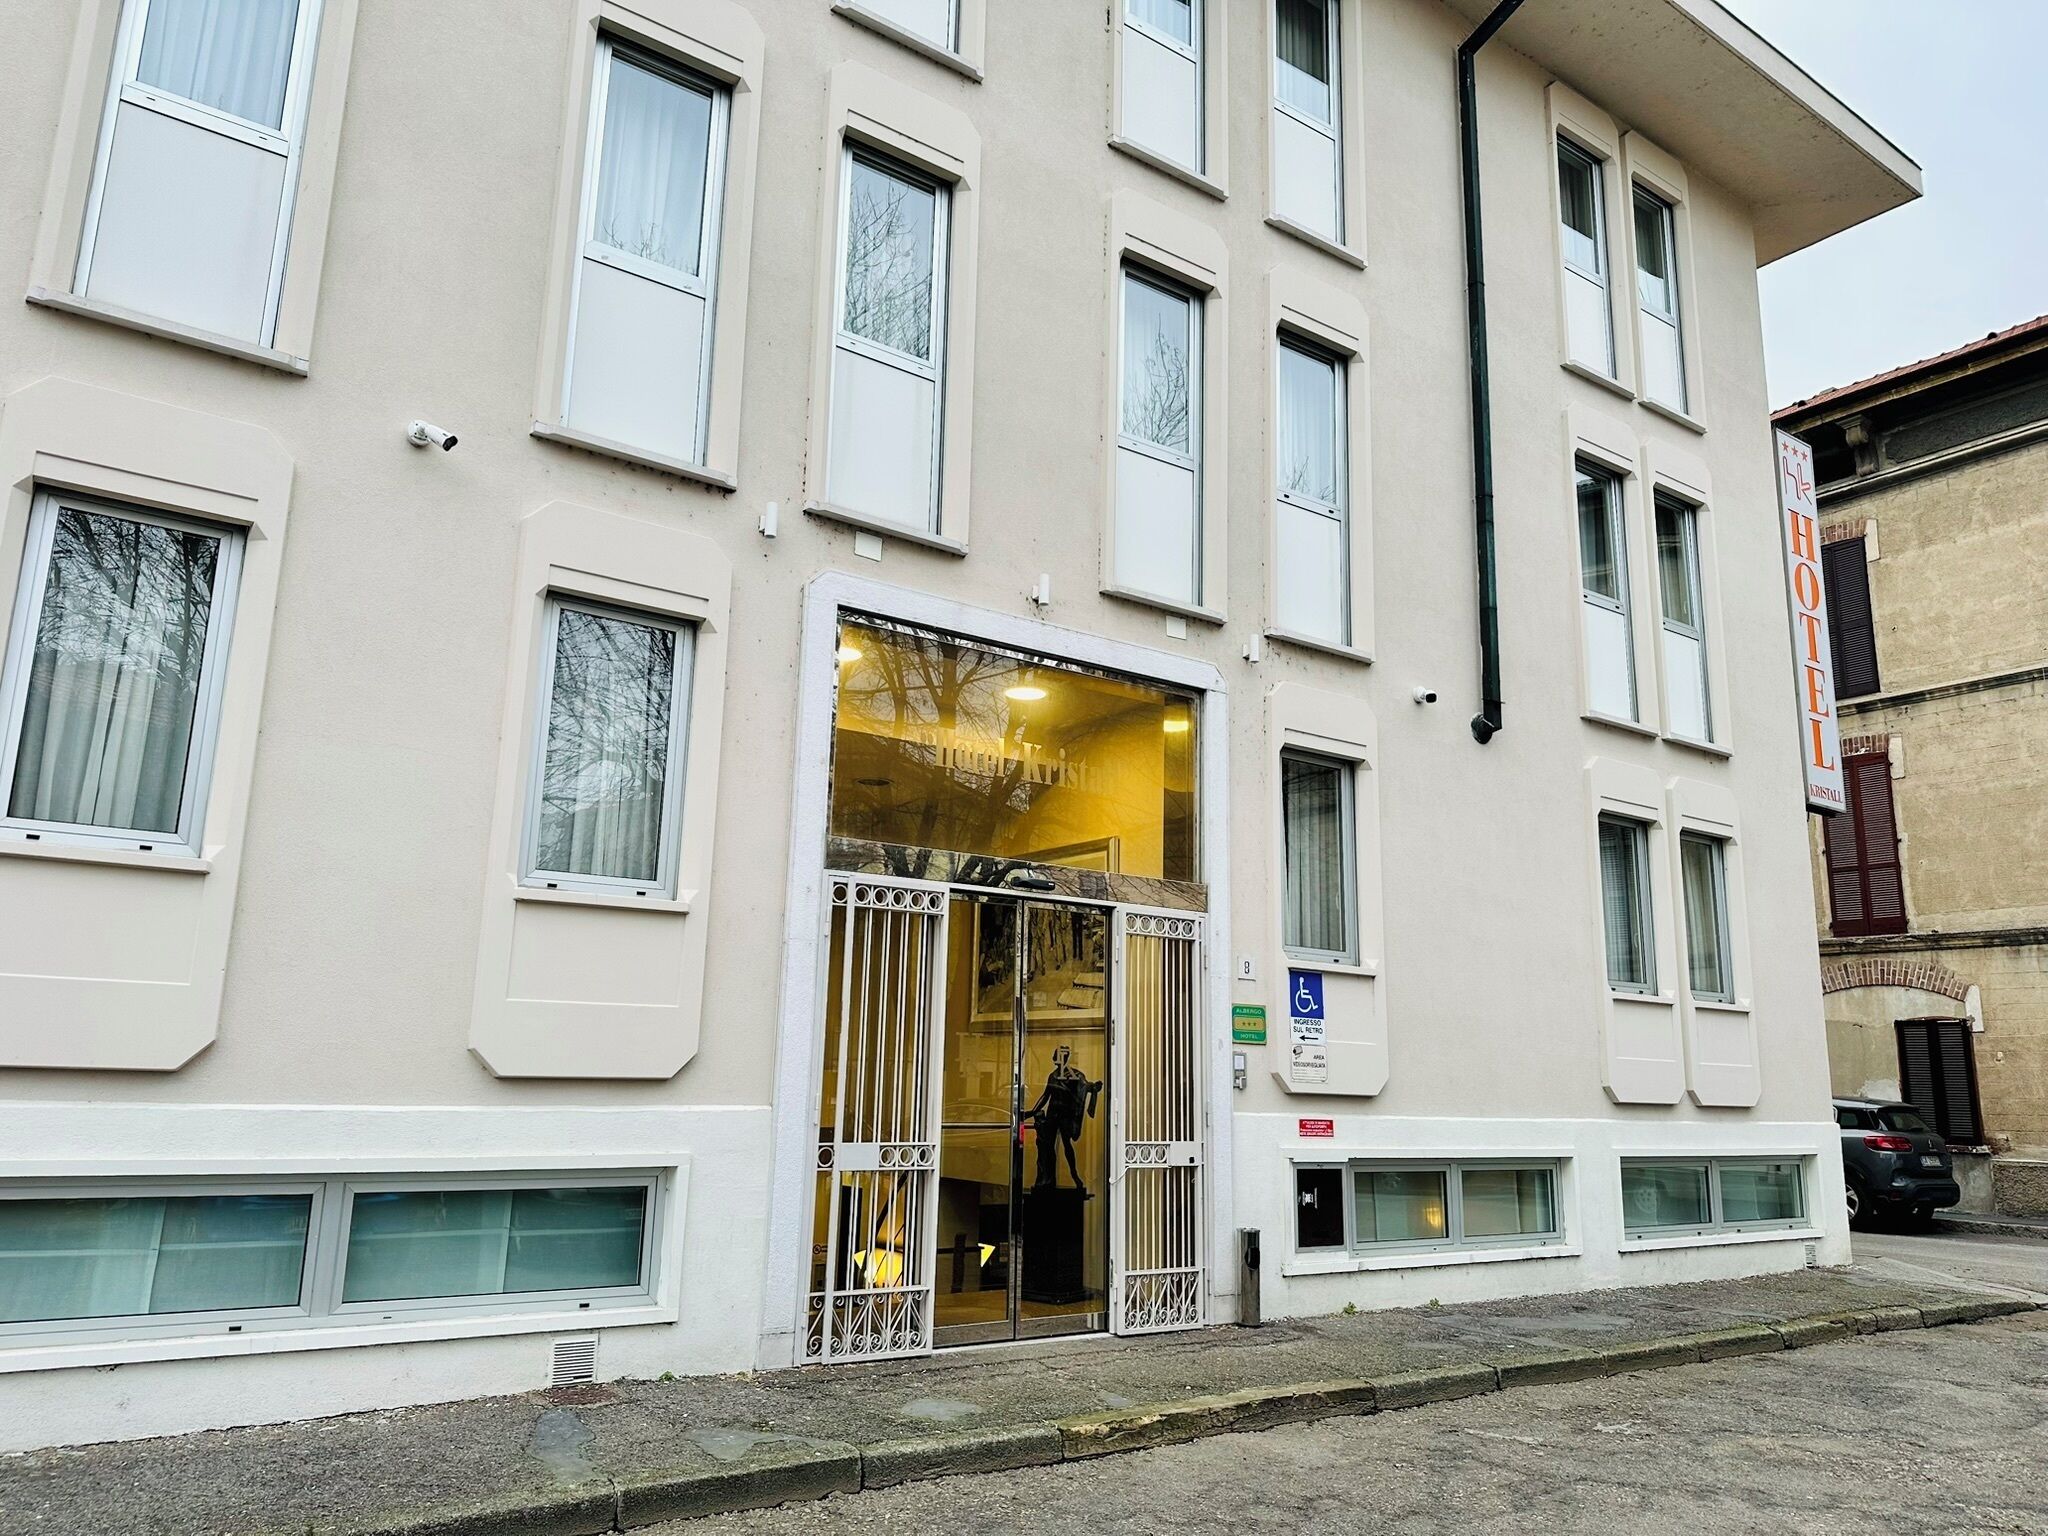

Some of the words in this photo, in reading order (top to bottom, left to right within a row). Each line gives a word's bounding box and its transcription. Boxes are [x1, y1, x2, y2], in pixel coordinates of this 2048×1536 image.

[1787, 507, 1836, 772] HOTEL
[1809, 783, 1843, 803] KRISTALL
[1244, 961, 1250, 974] 8
[1293, 1018, 1322, 1026] INGRESSO
[1293, 1025, 1304, 1033] SUL
[1305, 1026, 1323, 1034] RETRO
